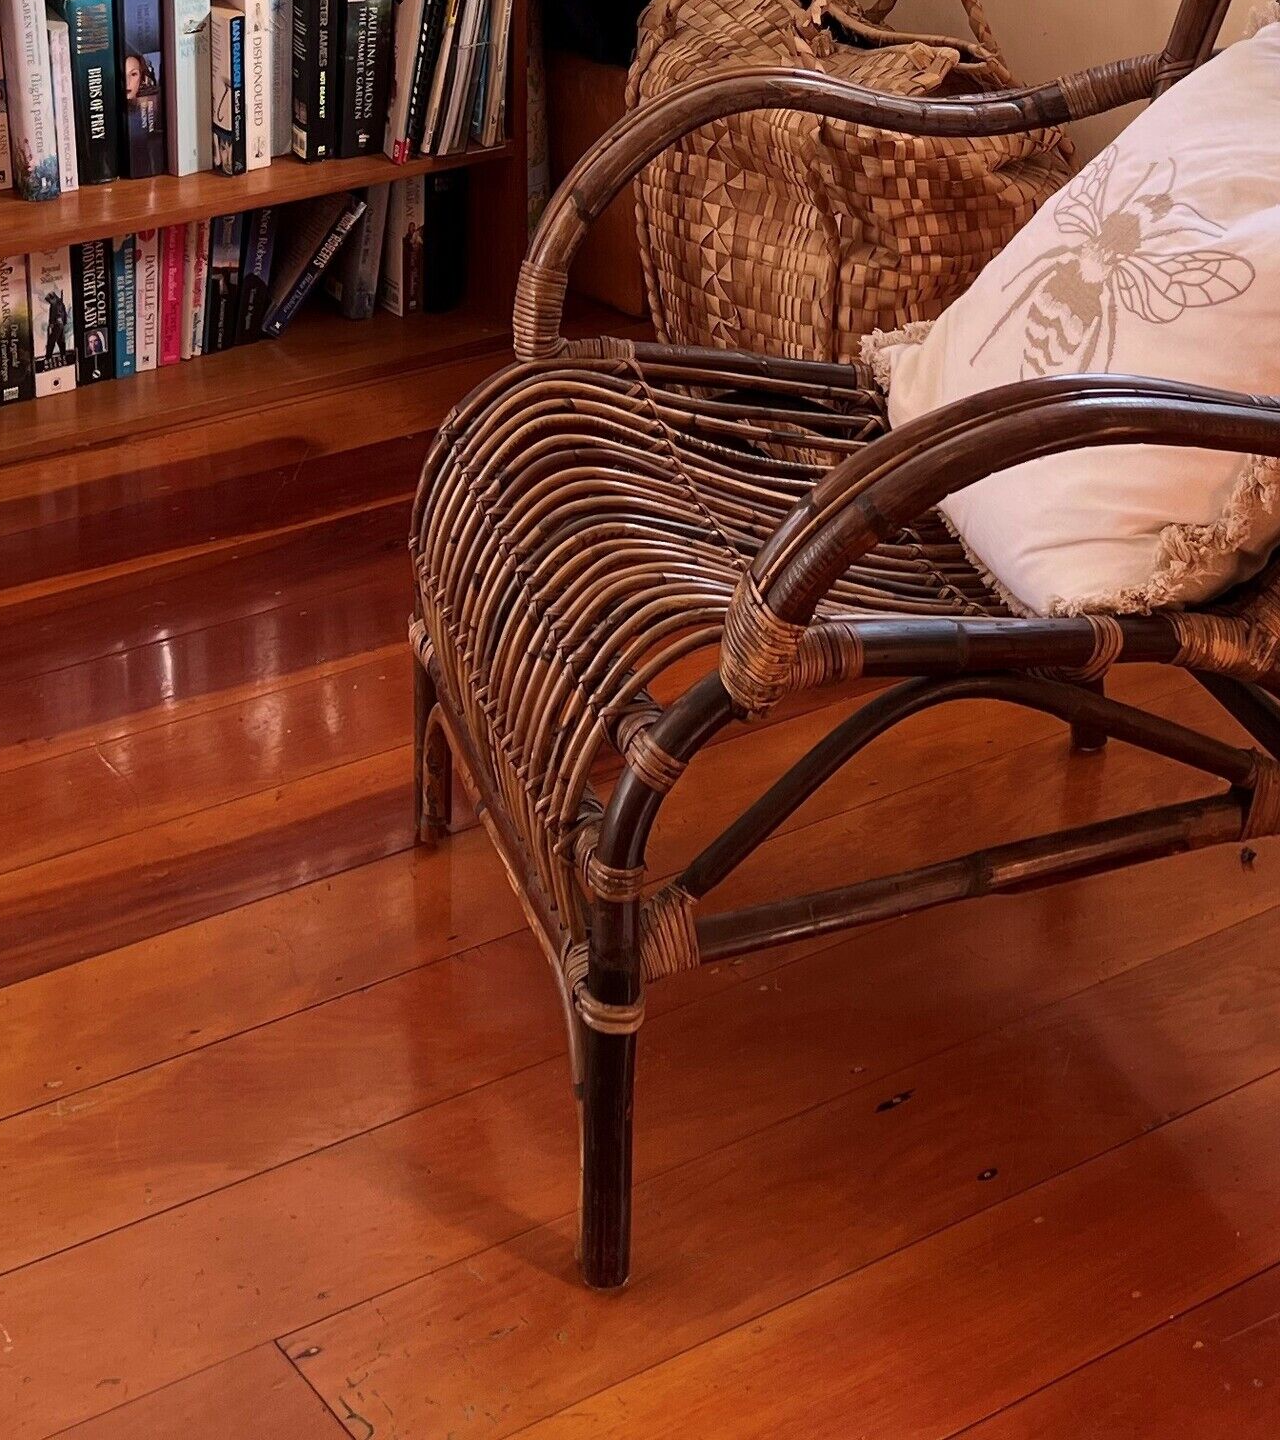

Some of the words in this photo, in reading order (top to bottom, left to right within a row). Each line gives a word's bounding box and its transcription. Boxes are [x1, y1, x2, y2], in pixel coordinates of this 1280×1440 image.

[358, 7, 367, 26] THE
[25, 32, 36, 66] WHITE
[318, 29, 328, 67] JAMES
[356, 30, 367, 75] SUMMER
[366, 7, 378, 66] PAULLINA
[87, 68, 103, 98] BIRDS
[232, 43, 241, 87] RANKIN
[253, 37, 263, 127] DISHONOURED
[29, 73, 43, 106] flight
[89, 99, 103, 112] OF
[354, 77, 364, 120] GARDEN
[363, 70, 375, 119] SIMONS
[31, 110, 44, 154] patterns
[91, 114, 105, 140] PREY
[95, 241, 105, 288] ARTINA
[253, 237, 268, 276] Roberts
[313, 233, 343, 269] ROBERTS
[0, 257, 10, 292] SARAH
[144, 255, 155, 311] DANIELLE
[84, 299, 98, 328] LADY
[96, 291, 106, 325] COLE
[144, 312, 155, 349] STEEL
